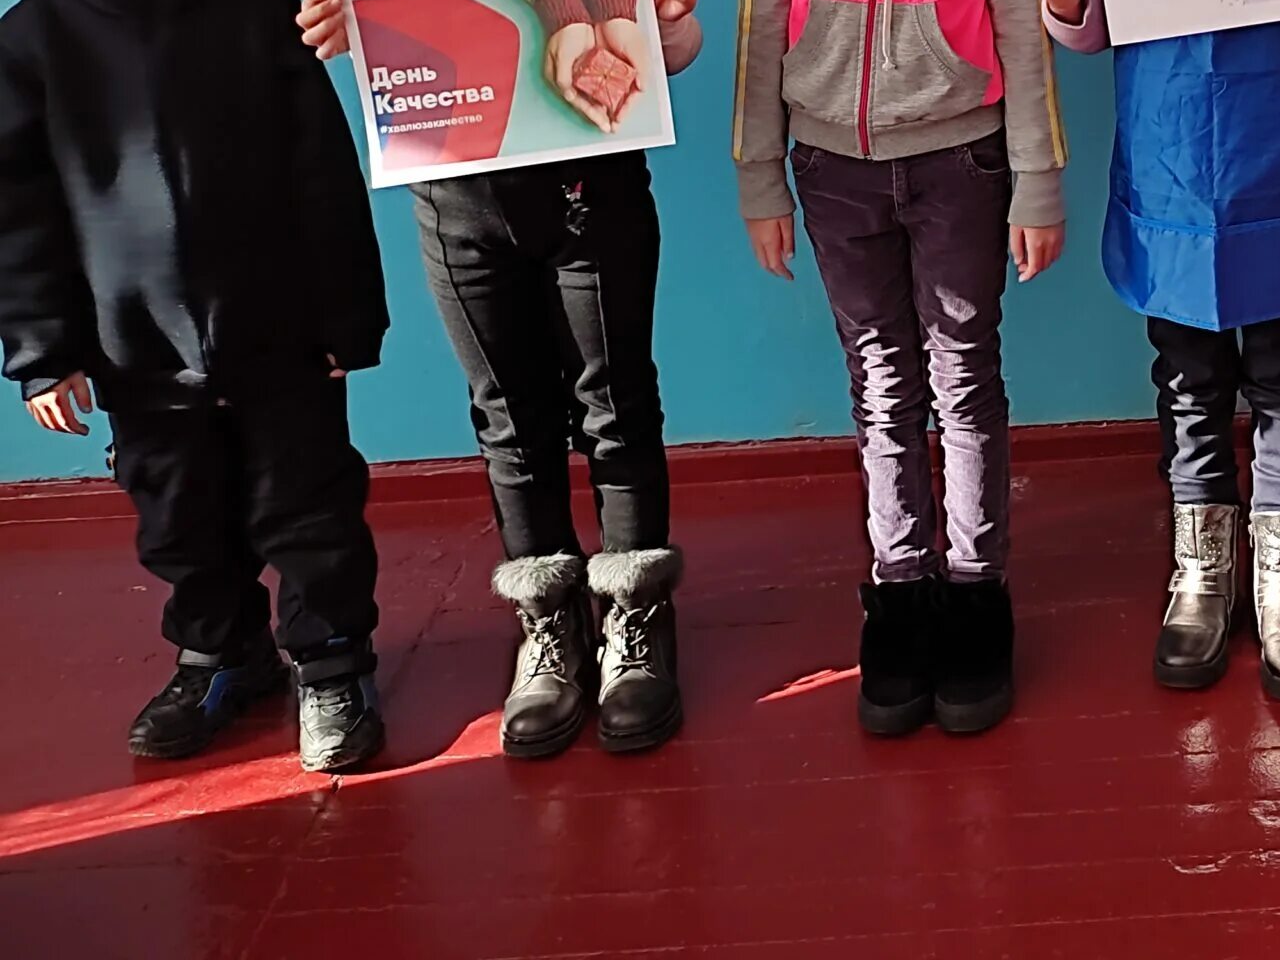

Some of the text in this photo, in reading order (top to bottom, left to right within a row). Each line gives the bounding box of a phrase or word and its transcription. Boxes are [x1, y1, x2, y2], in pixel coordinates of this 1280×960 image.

[371, 66, 437, 91] День
[375, 85, 494, 115] Качества
[380, 115, 483, 134] #хвалюзакачество
